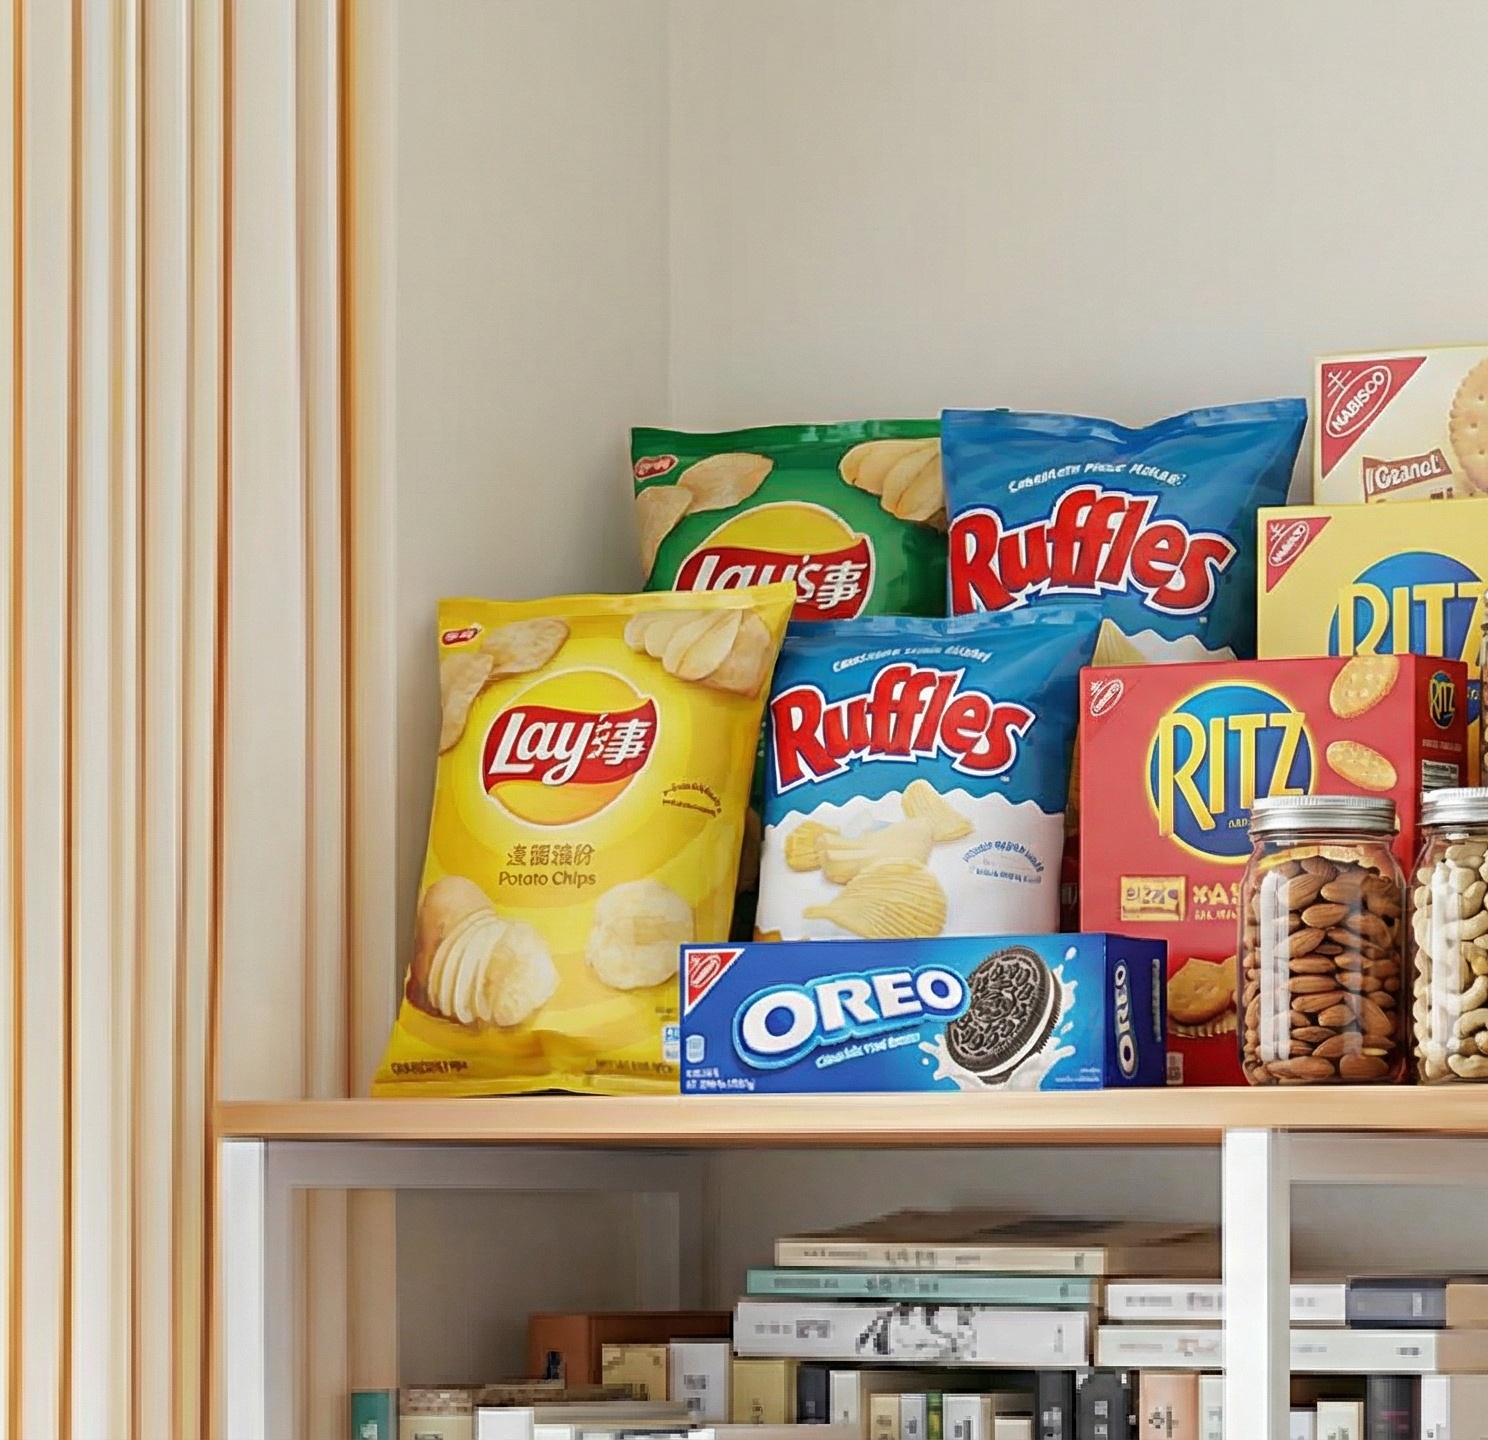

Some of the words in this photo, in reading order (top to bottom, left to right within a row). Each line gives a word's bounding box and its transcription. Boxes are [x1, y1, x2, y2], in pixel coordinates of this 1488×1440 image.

[1330, 371, 1386, 433] NABISCO
[947, 485, 1236, 618] Ruffles
[770, 663, 1036, 795] Ruffles
[1157, 711, 1306, 837] RITZ
[498, 870, 549, 887] Potato
[552, 870, 597, 890] Chips
[741, 969, 963, 1054] OREO
